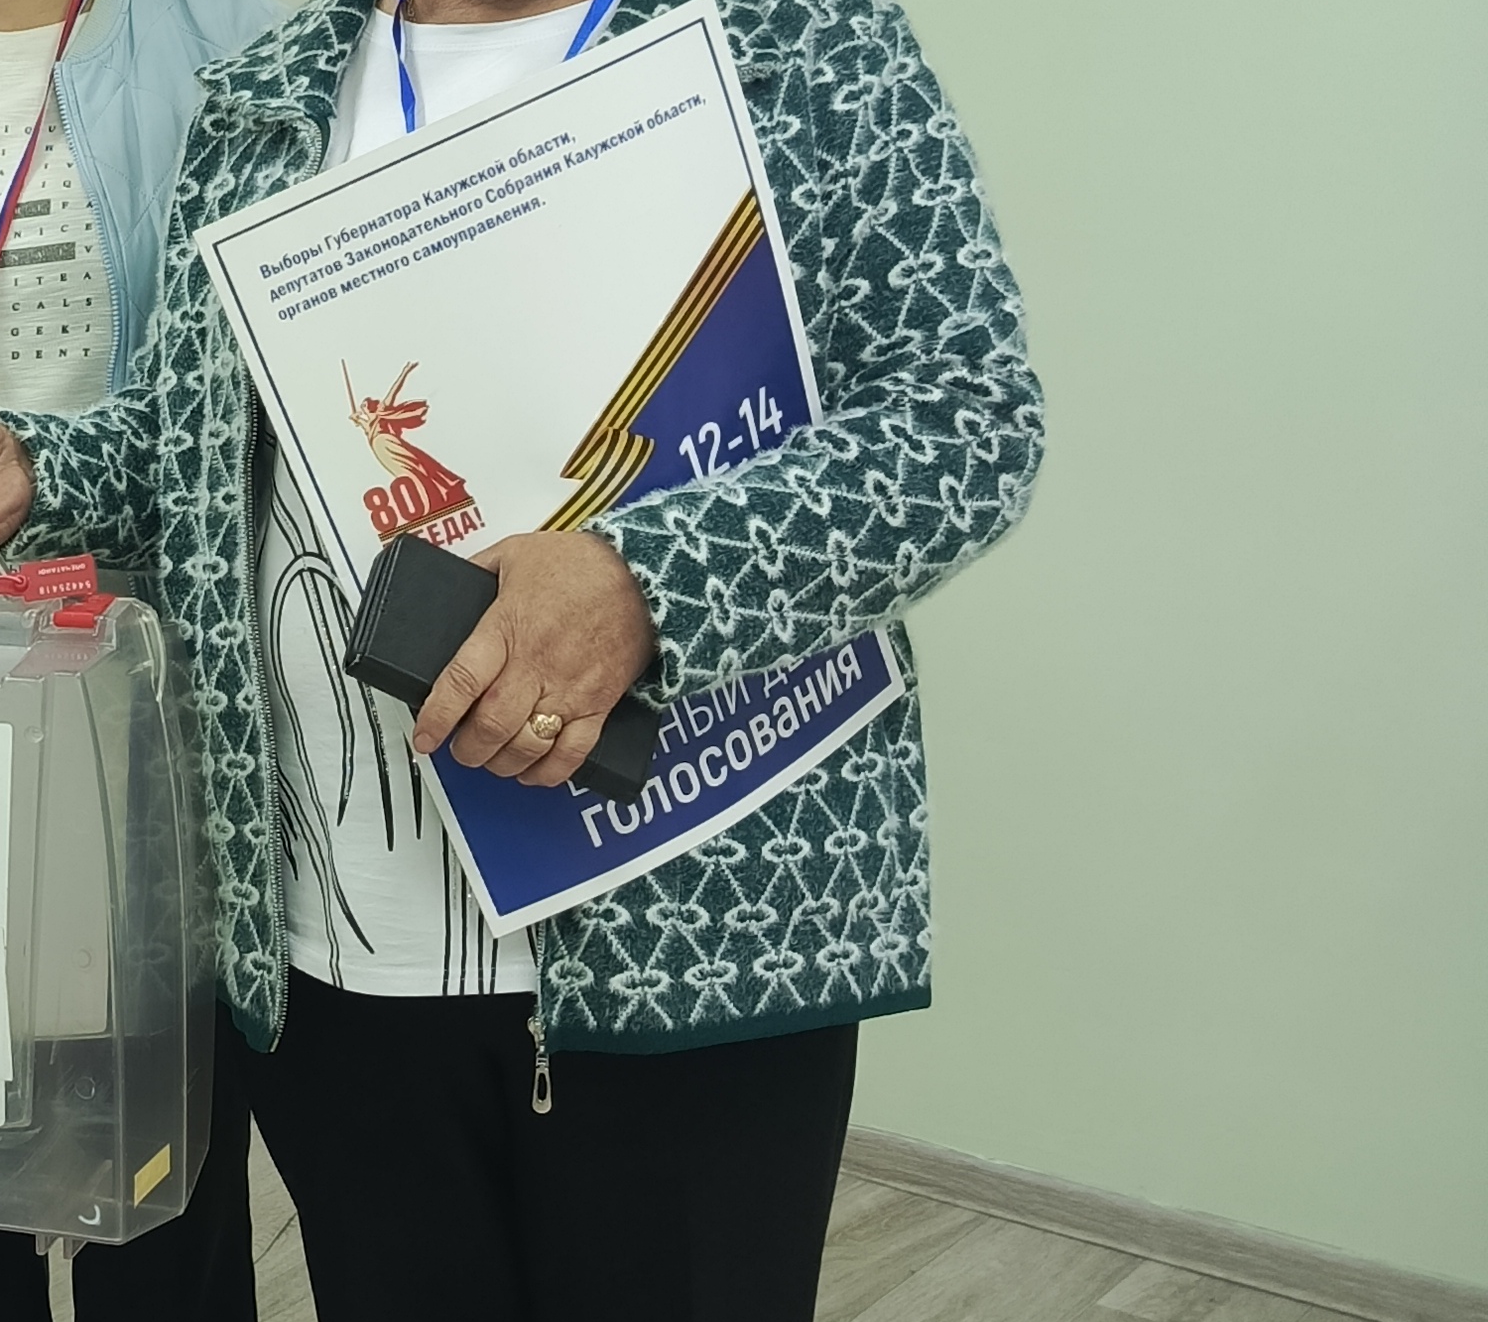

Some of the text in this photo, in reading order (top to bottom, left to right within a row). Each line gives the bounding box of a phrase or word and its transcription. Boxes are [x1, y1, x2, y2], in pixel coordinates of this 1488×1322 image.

[259, 132, 577, 279] Выборы Губернатора Калужской области,
[269, 93, 707, 303] депутатов Законодательного Собрания Калужской области,
[277, 196, 547, 321] органов местного самоуправления.
[679, 386, 783, 479] 12-14
[362, 475, 425, 533] 80
[581, 643, 863, 848] голосования
